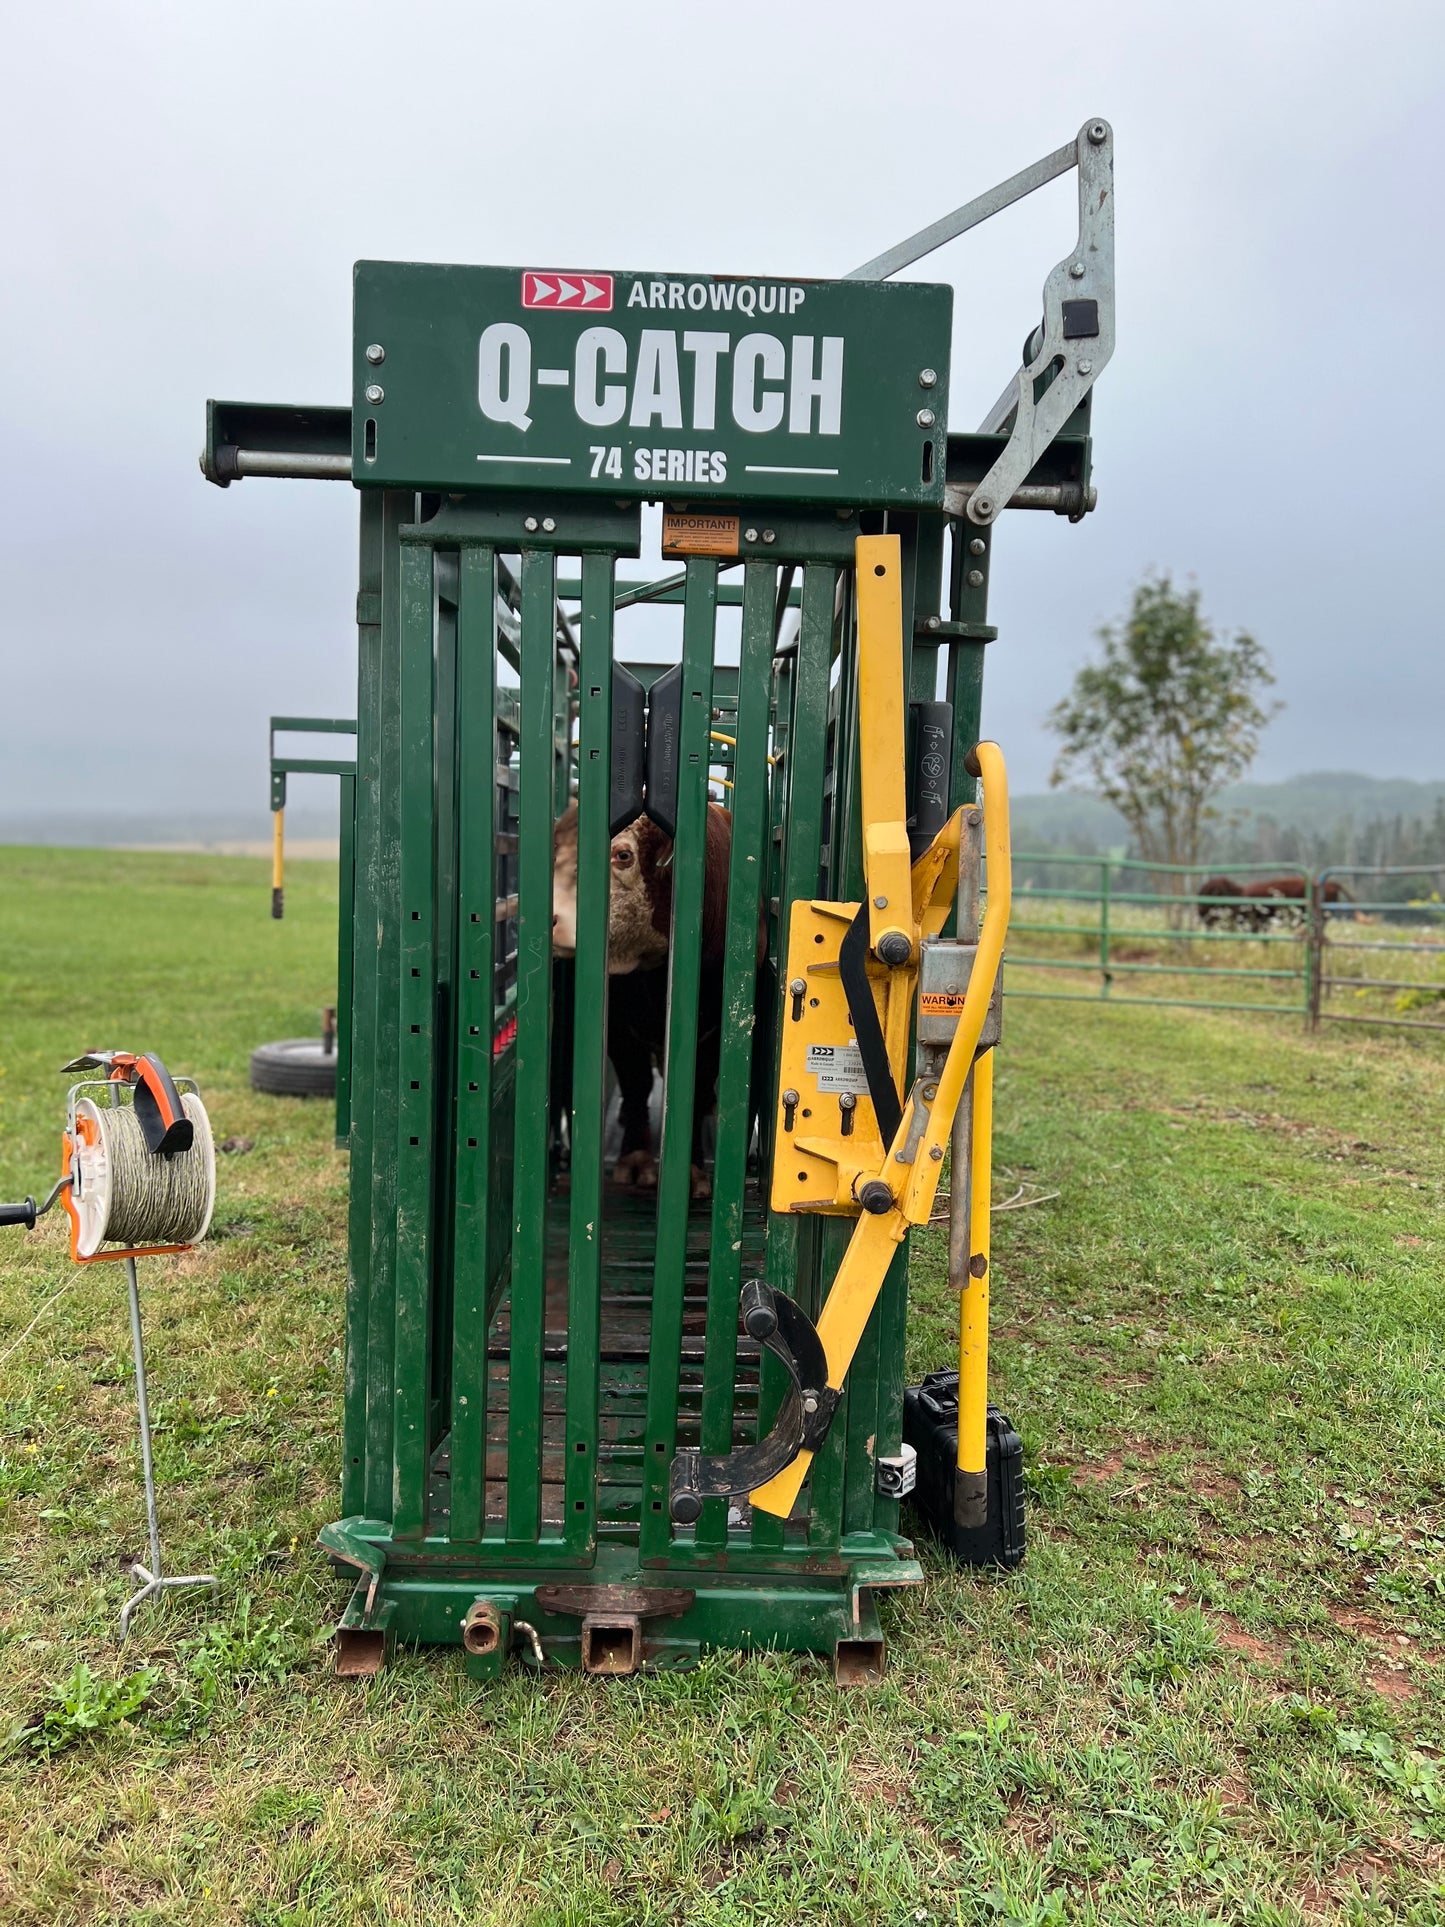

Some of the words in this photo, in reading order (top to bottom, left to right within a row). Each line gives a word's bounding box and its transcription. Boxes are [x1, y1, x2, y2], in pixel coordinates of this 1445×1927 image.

[626, 280, 806, 318] ARROWQUIP
[478, 322, 845, 435] Q-CATCH
[589, 445, 623, 479] 74
[634, 448, 727, 484] SERIES
[667, 518, 736, 530] IMPORTANT!
[922, 995, 966, 1006] WARNIN
